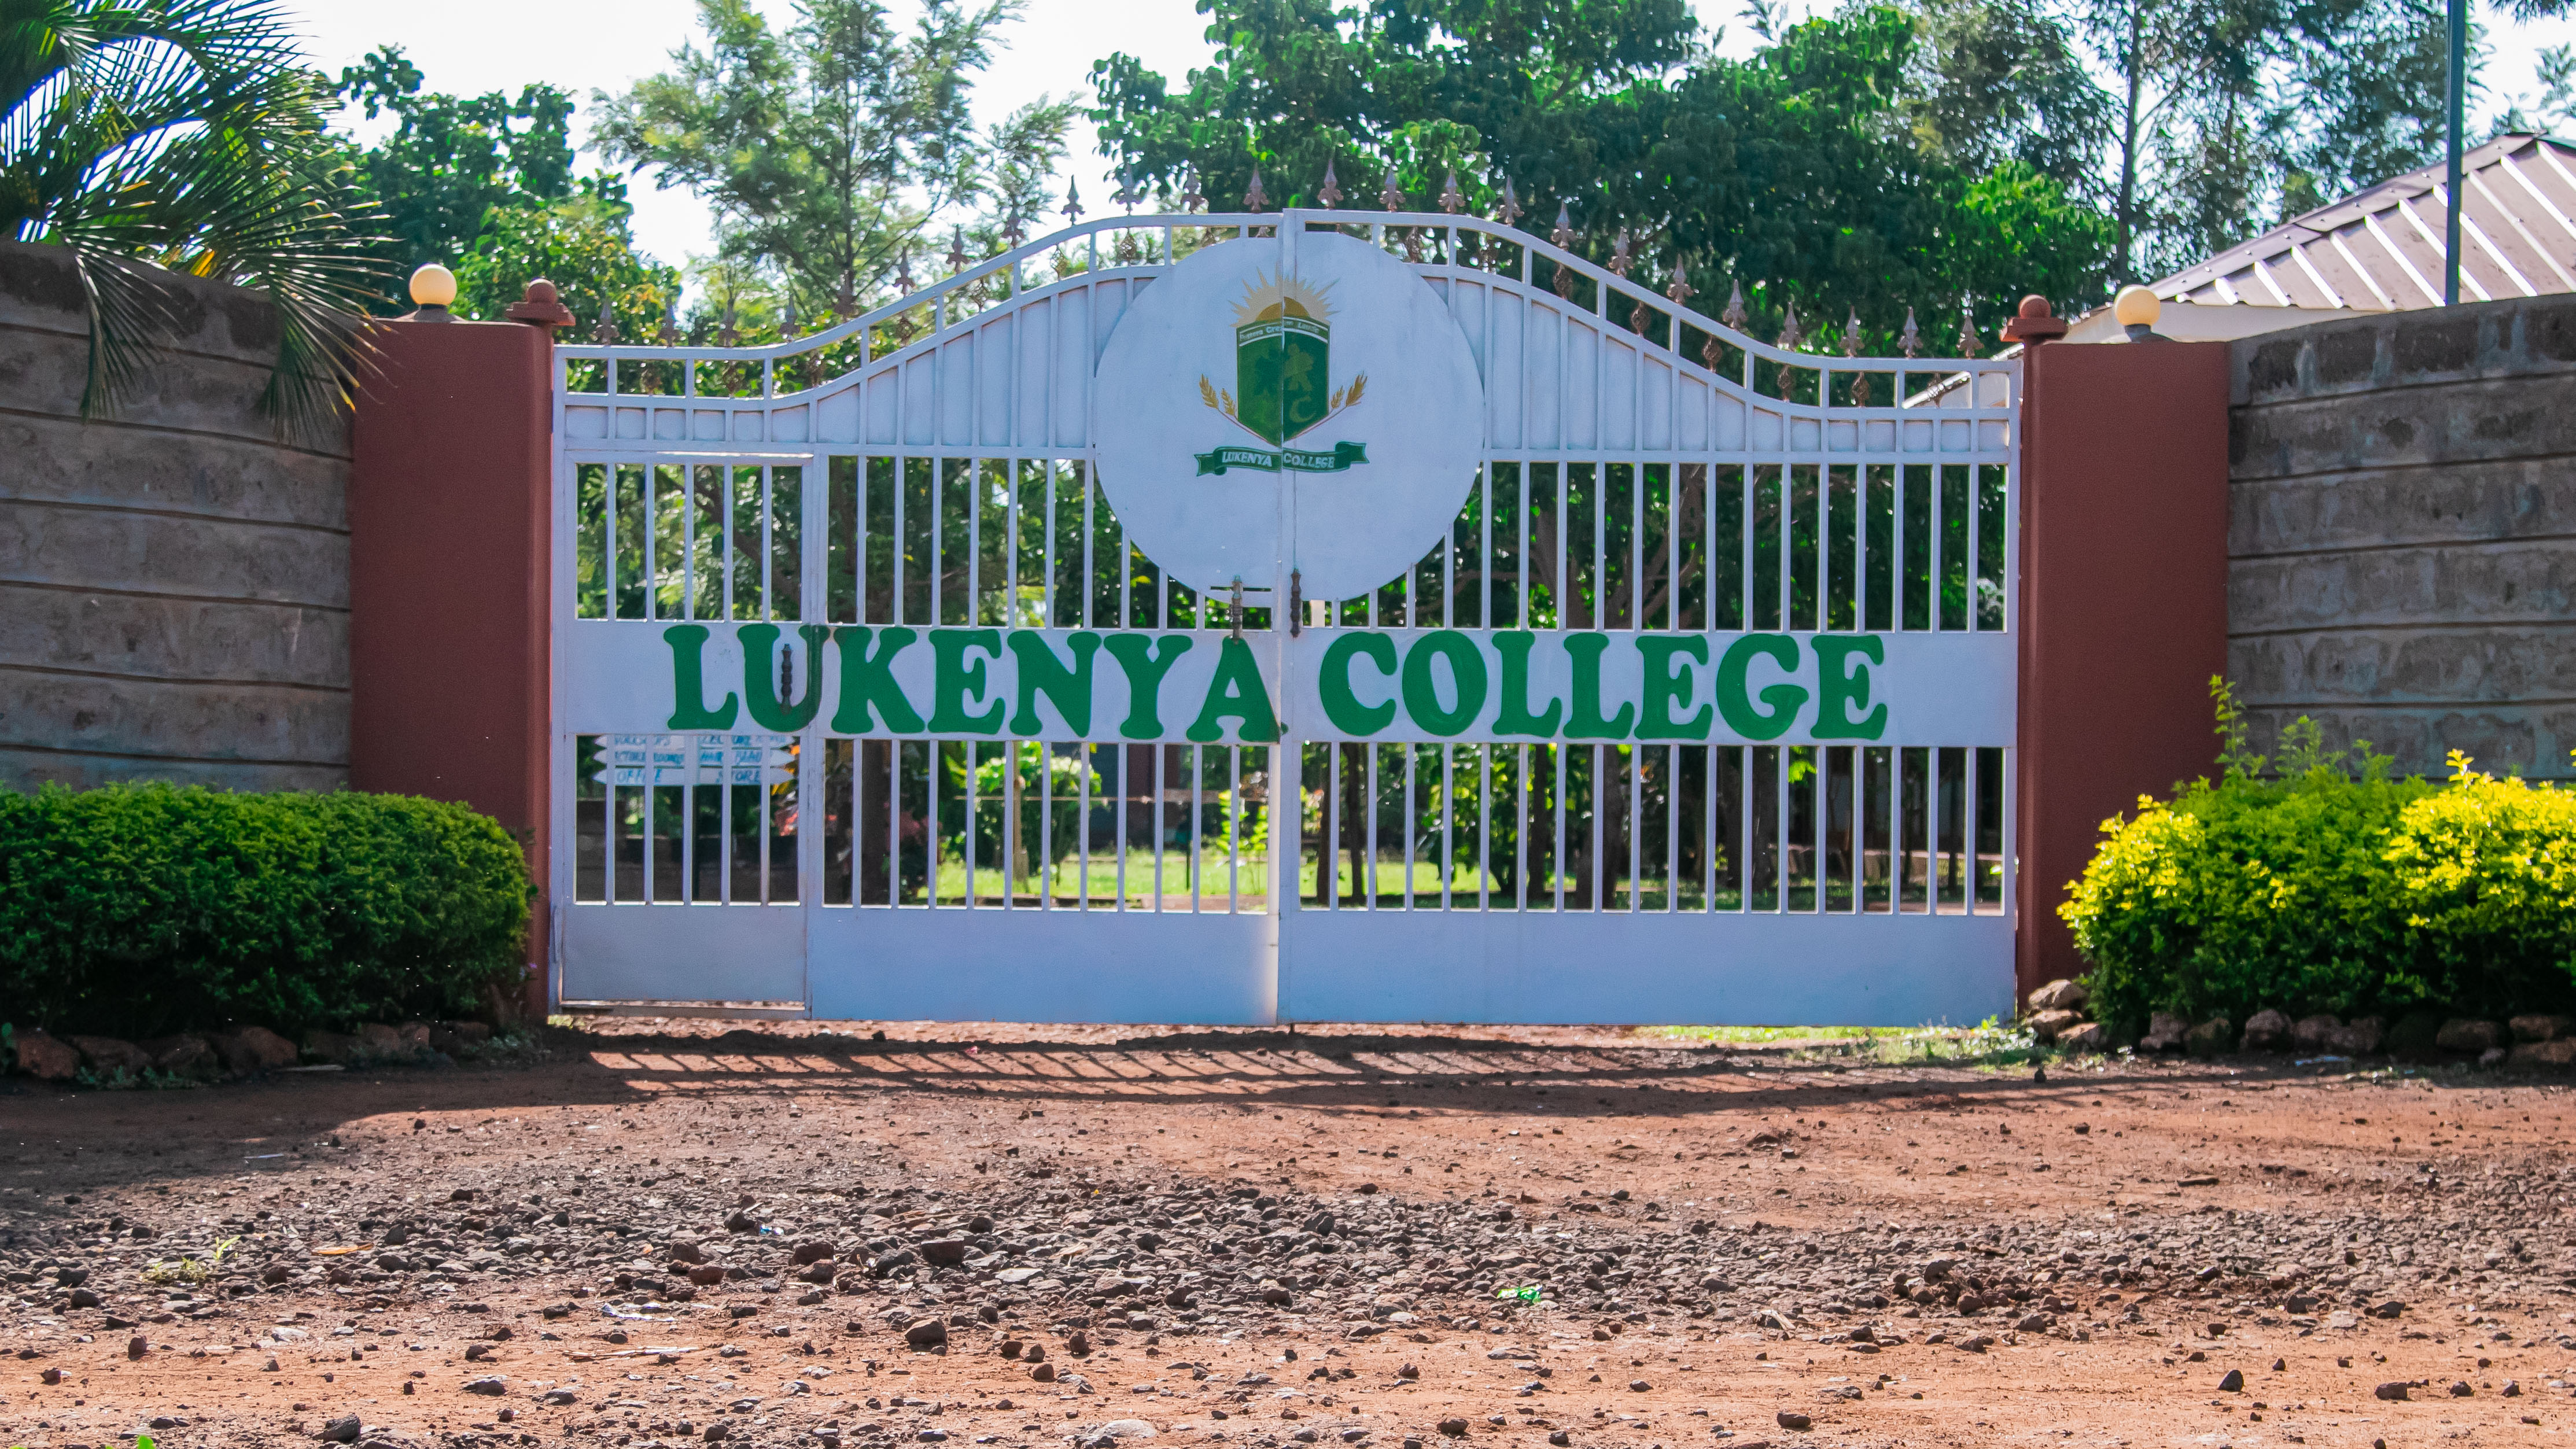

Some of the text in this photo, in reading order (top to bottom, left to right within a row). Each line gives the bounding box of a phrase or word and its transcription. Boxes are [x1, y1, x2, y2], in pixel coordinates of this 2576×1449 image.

[1222, 451, 1335, 469] LUKENYA COLLEGE
[664, 623, 1888, 743] LUKENYA COLLEGE
